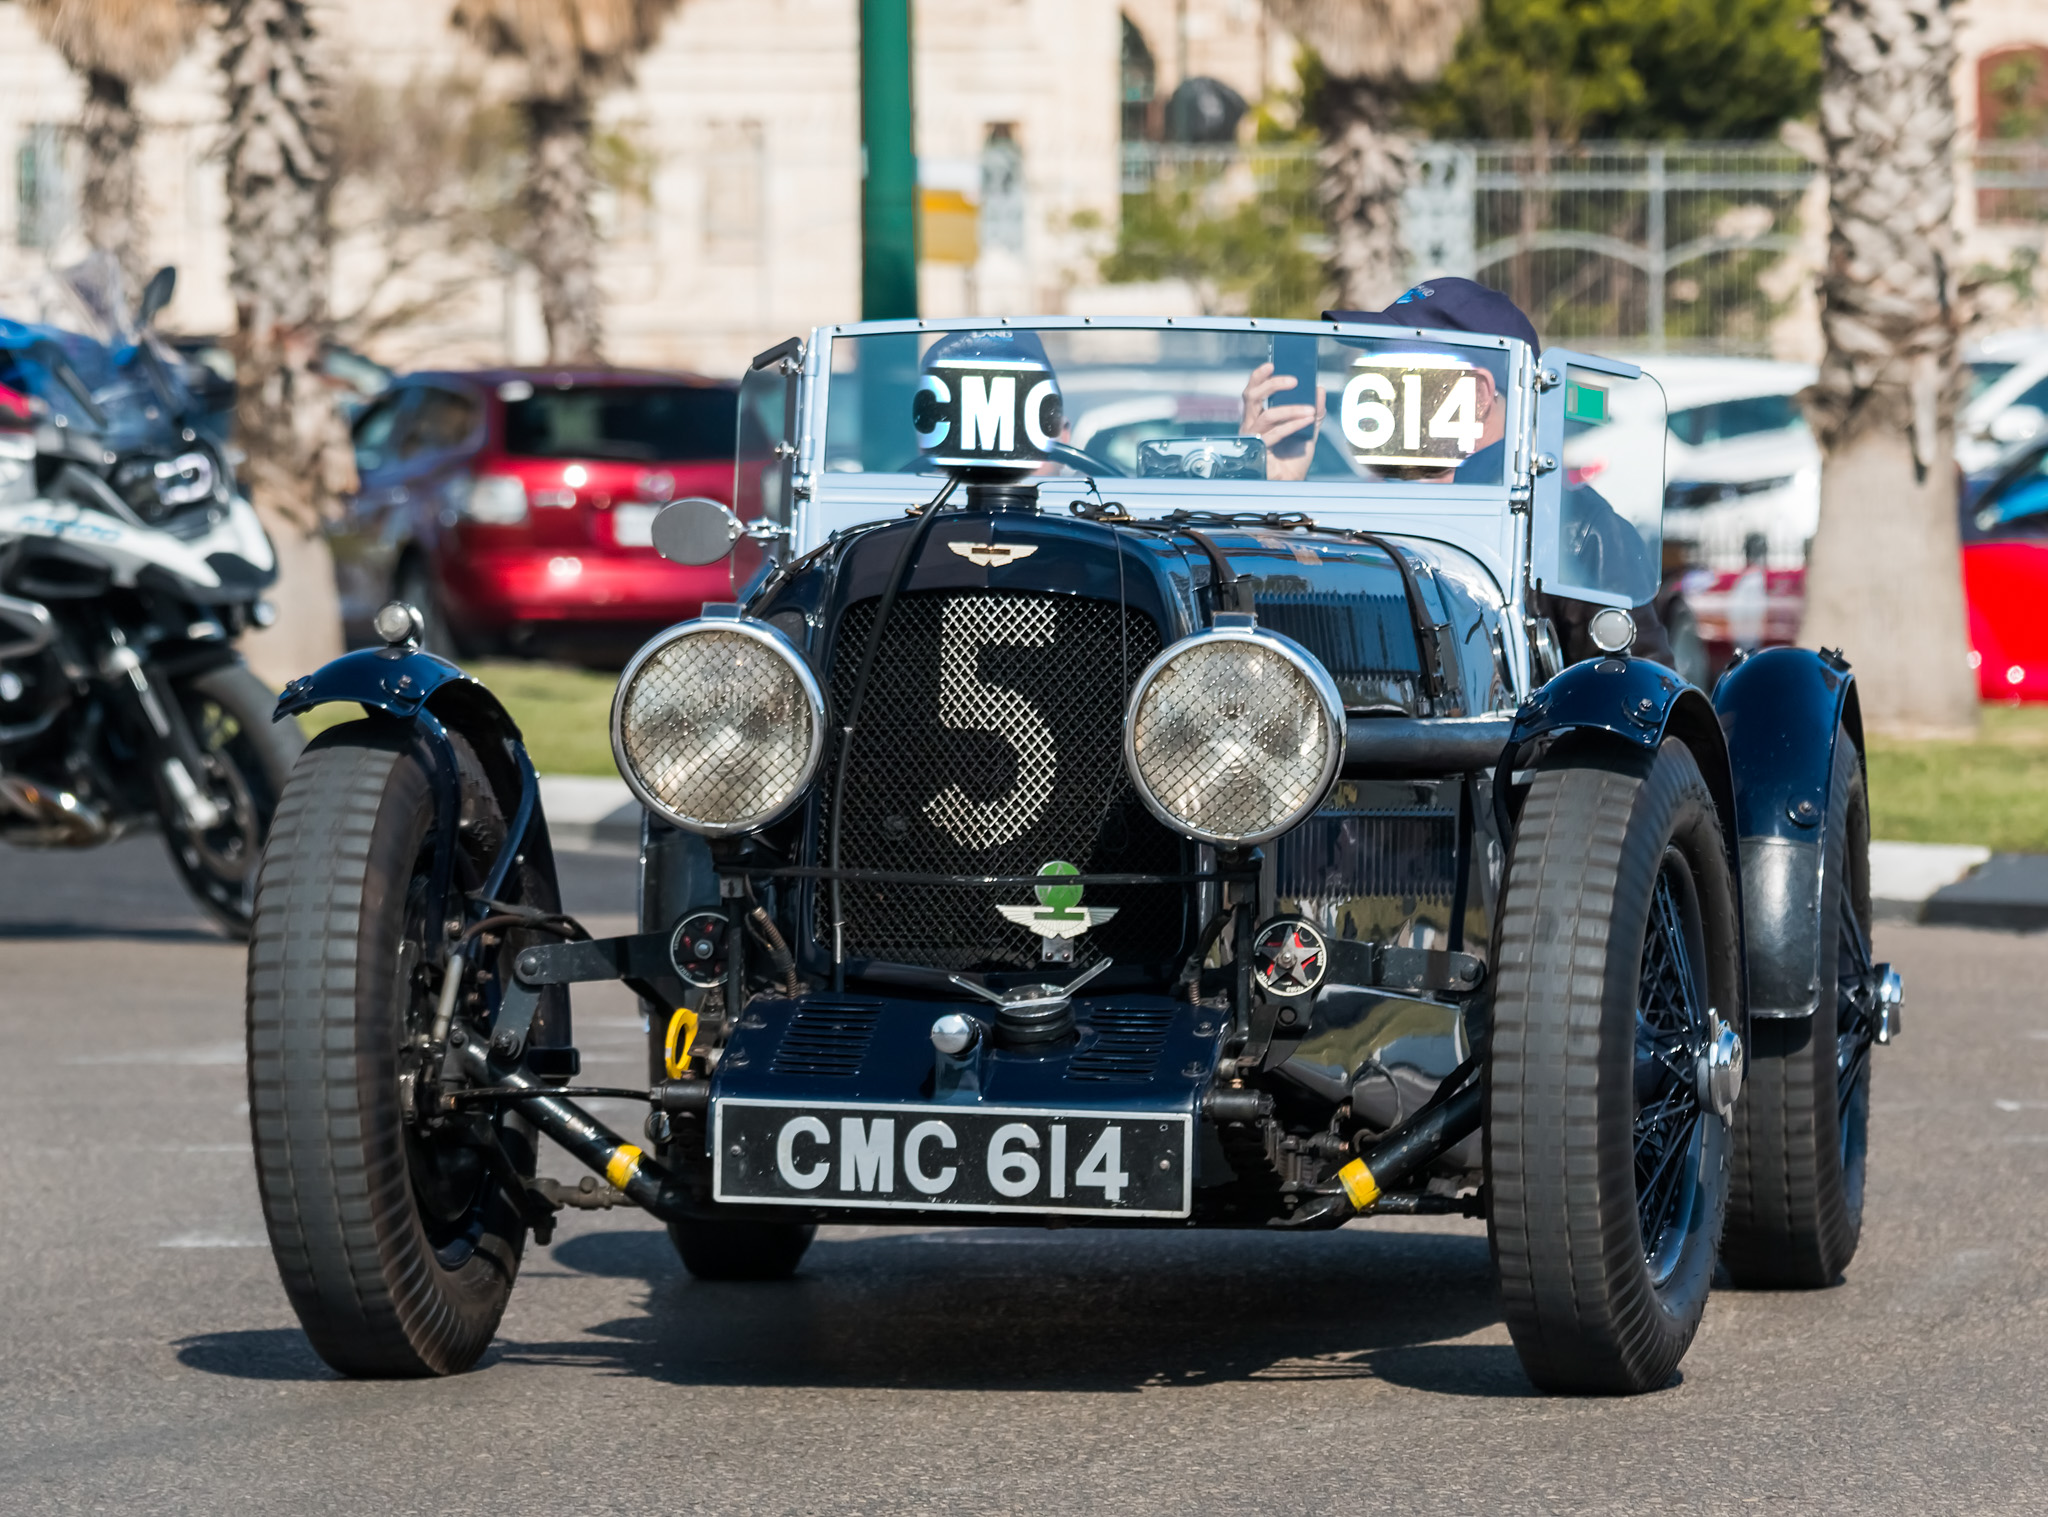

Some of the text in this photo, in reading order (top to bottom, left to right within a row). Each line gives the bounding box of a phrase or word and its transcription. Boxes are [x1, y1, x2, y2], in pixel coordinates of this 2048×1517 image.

[922, 595, 1058, 850] 5
[776, 1115, 1129, 1201] CMC 614
